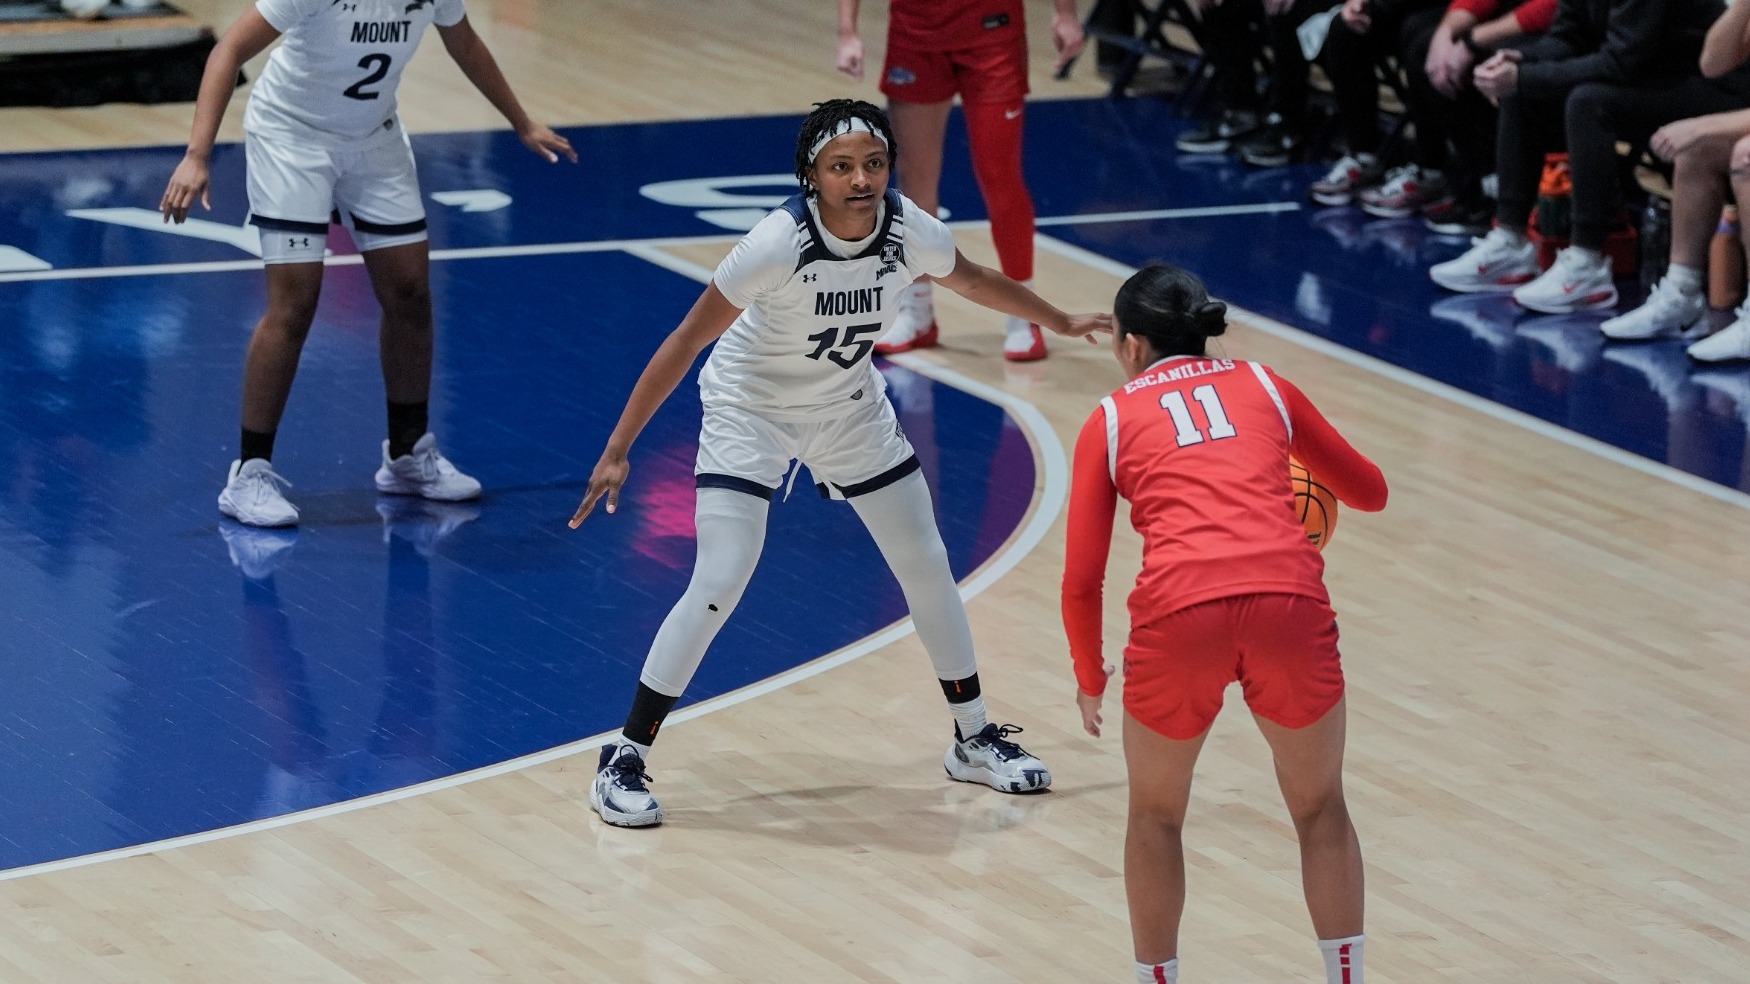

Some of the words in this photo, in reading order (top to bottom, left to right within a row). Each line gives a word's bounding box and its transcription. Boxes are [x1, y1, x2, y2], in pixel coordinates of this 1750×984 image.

[350, 21, 411, 43] MOUNT
[342, 52, 392, 101] 2
[814, 286, 883, 316] MOUNT
[804, 321, 882, 370] 15
[1123, 359, 1236, 395] ESCANILLAS
[1159, 384, 1238, 448] 11
